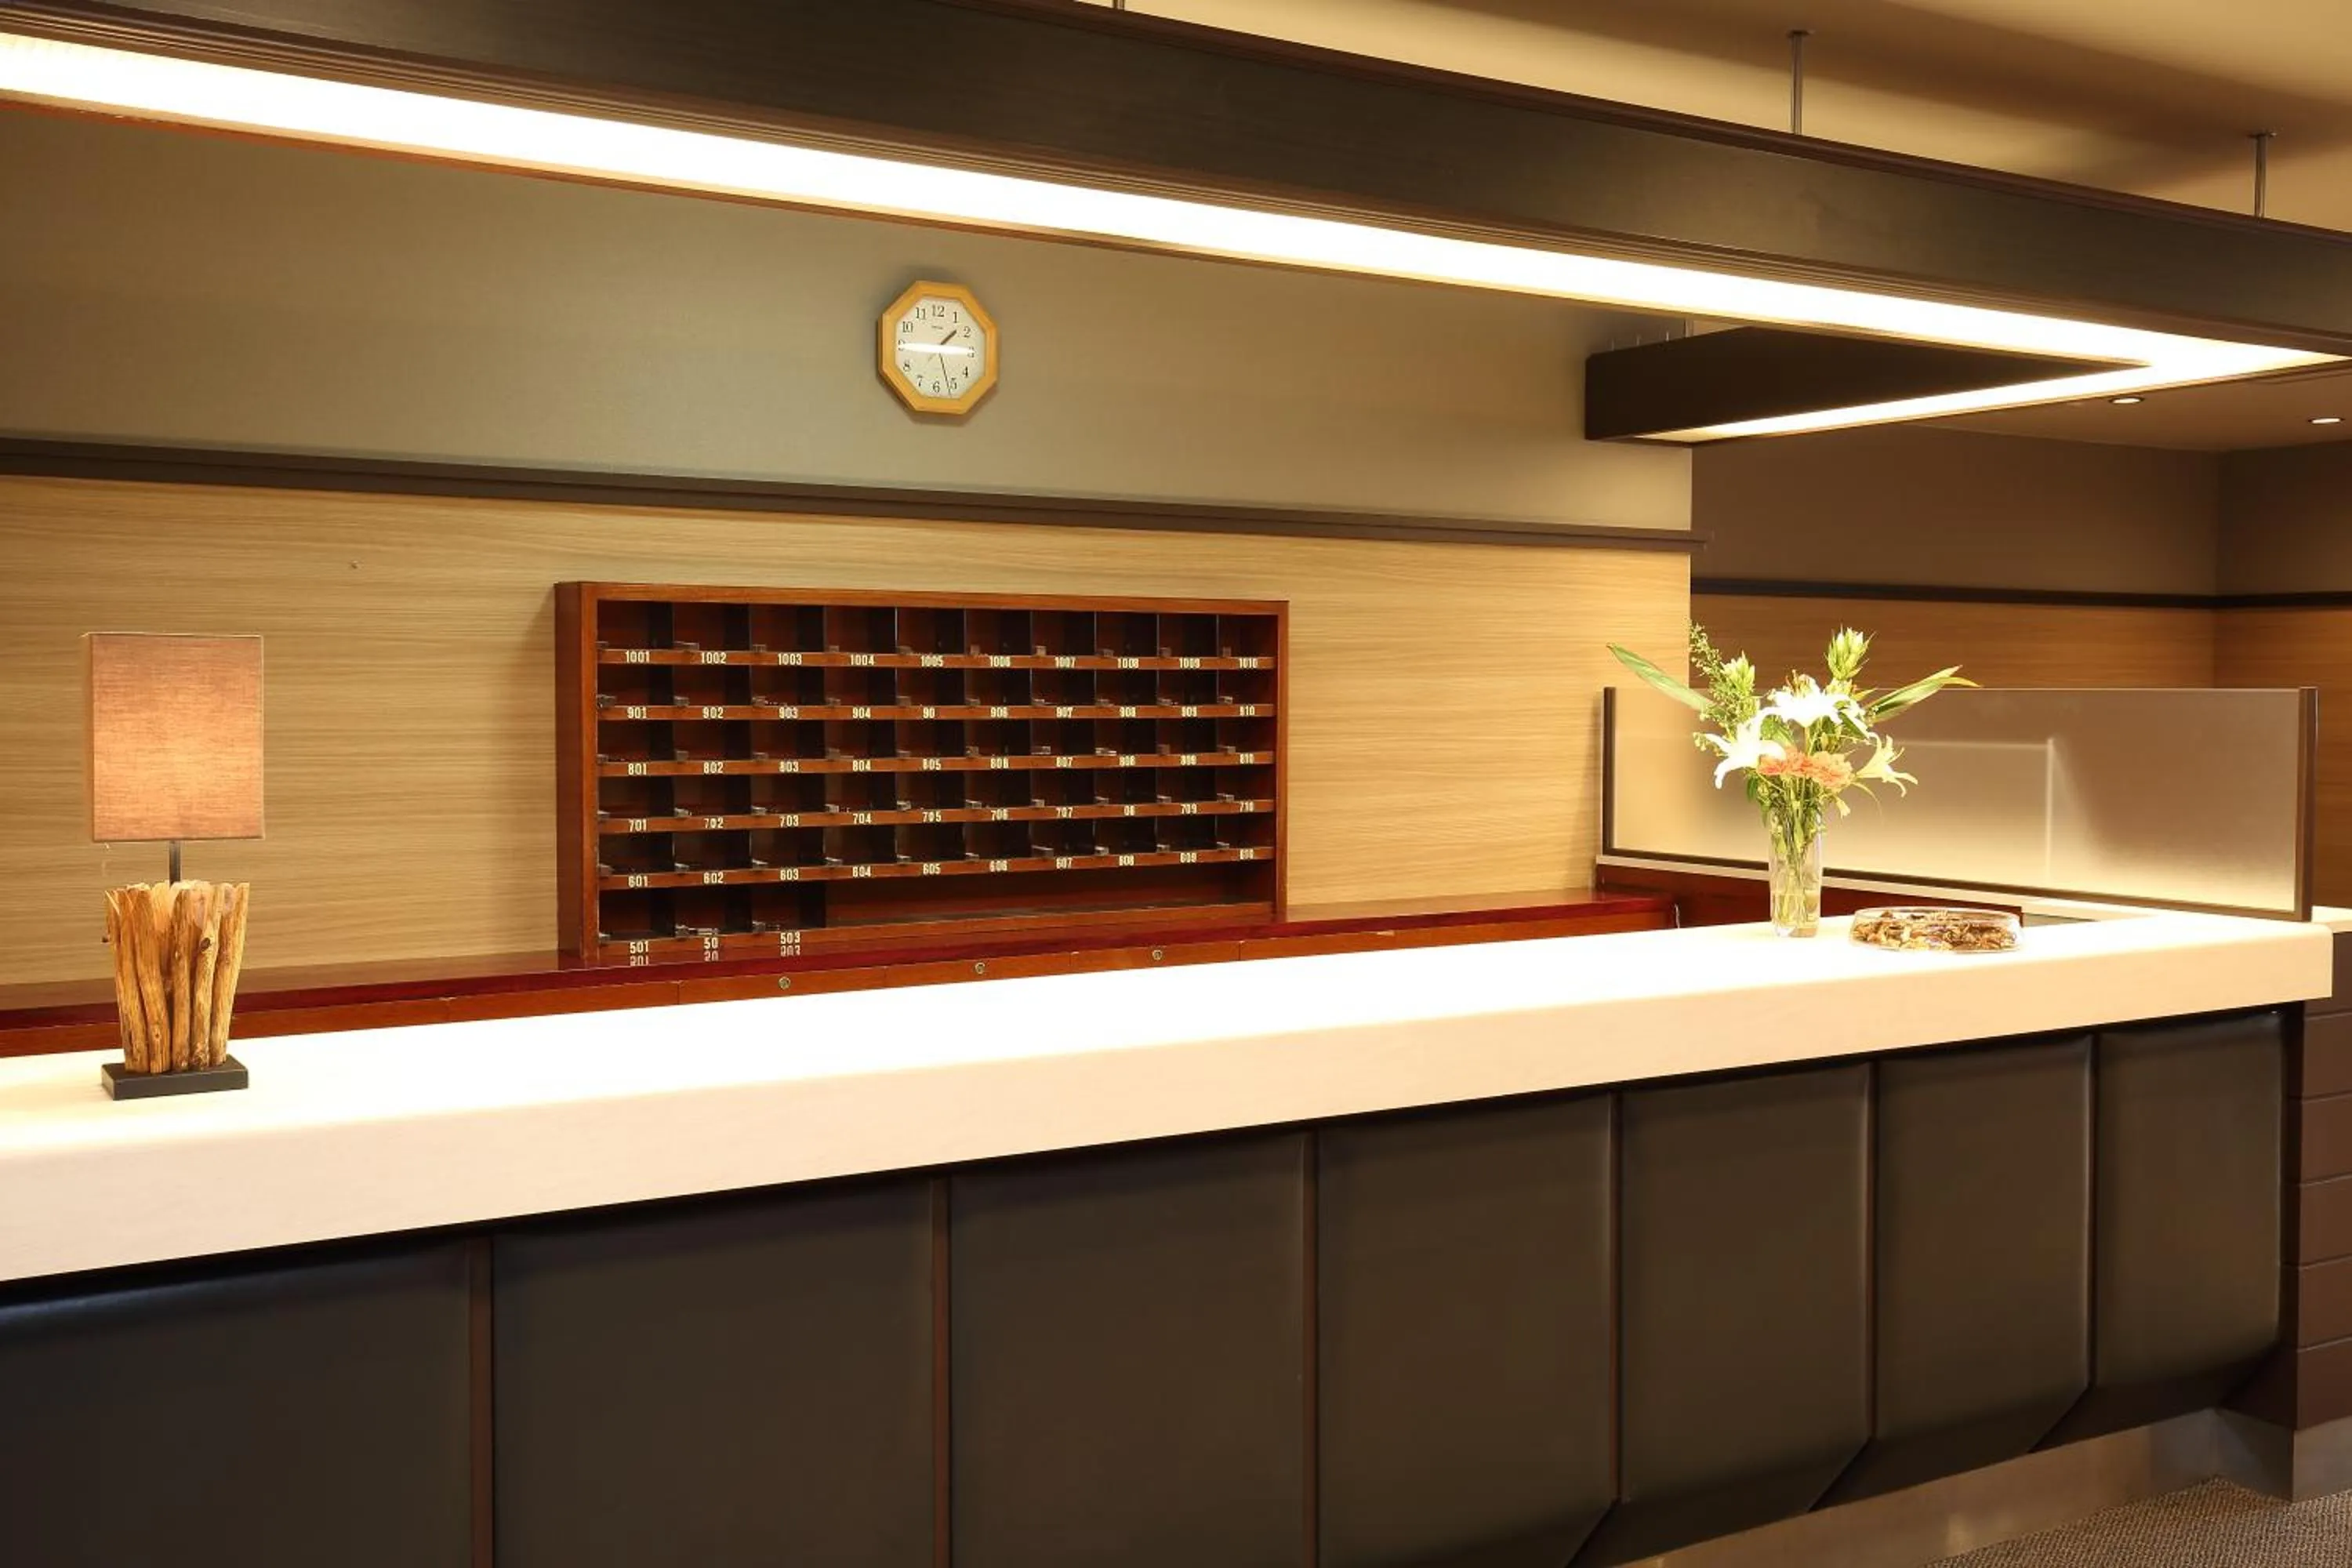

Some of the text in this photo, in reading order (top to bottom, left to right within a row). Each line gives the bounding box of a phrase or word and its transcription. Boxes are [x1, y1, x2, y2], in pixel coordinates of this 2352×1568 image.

[916, 307, 926, 320] 11
[931, 305, 945, 318] 12
[953, 311, 958, 324] 1
[902, 321, 913, 333] 10
[964, 326, 971, 338] 2
[903, 361, 911, 372] 8
[963, 366, 969, 378] 4
[916, 375, 923, 387] 7
[950, 378, 957, 390] 5
[933, 382, 940, 394] 6
[625, 650, 650, 663] 1001
[701, 652, 727, 664] 1002
[778, 652, 802, 666] 1003
[851, 654, 874, 666] 1004
[1117, 658, 1139, 669] 1008
[1239, 657, 1258, 669] 1010
[627, 706, 647, 719] 901
[702, 706, 724, 719] 902
[779, 706, 798, 719] 903
[852, 706, 871, 719] 904
[923, 706, 935, 719] 90
[628, 763, 647, 775] 801
[703, 760, 724, 774] 802
[779, 760, 799, 773] 803
[852, 760, 871, 772] 804
[923, 758, 942, 771] 805
[629, 818, 647, 833] 701
[704, 817, 724, 829] 702
[780, 815, 799, 829] 703
[852, 813, 872, 825] 704
[923, 811, 942, 822] 705
[1056, 807, 1073, 818] 707
[1181, 803, 1197, 815] 709
[628, 874, 648, 888] 601
[703, 871, 724, 884] 602
[780, 868, 799, 880] 603
[852, 866, 871, 878] 604
[923, 862, 940, 875] 605
[630, 931, 800, 954] 501 50 503
